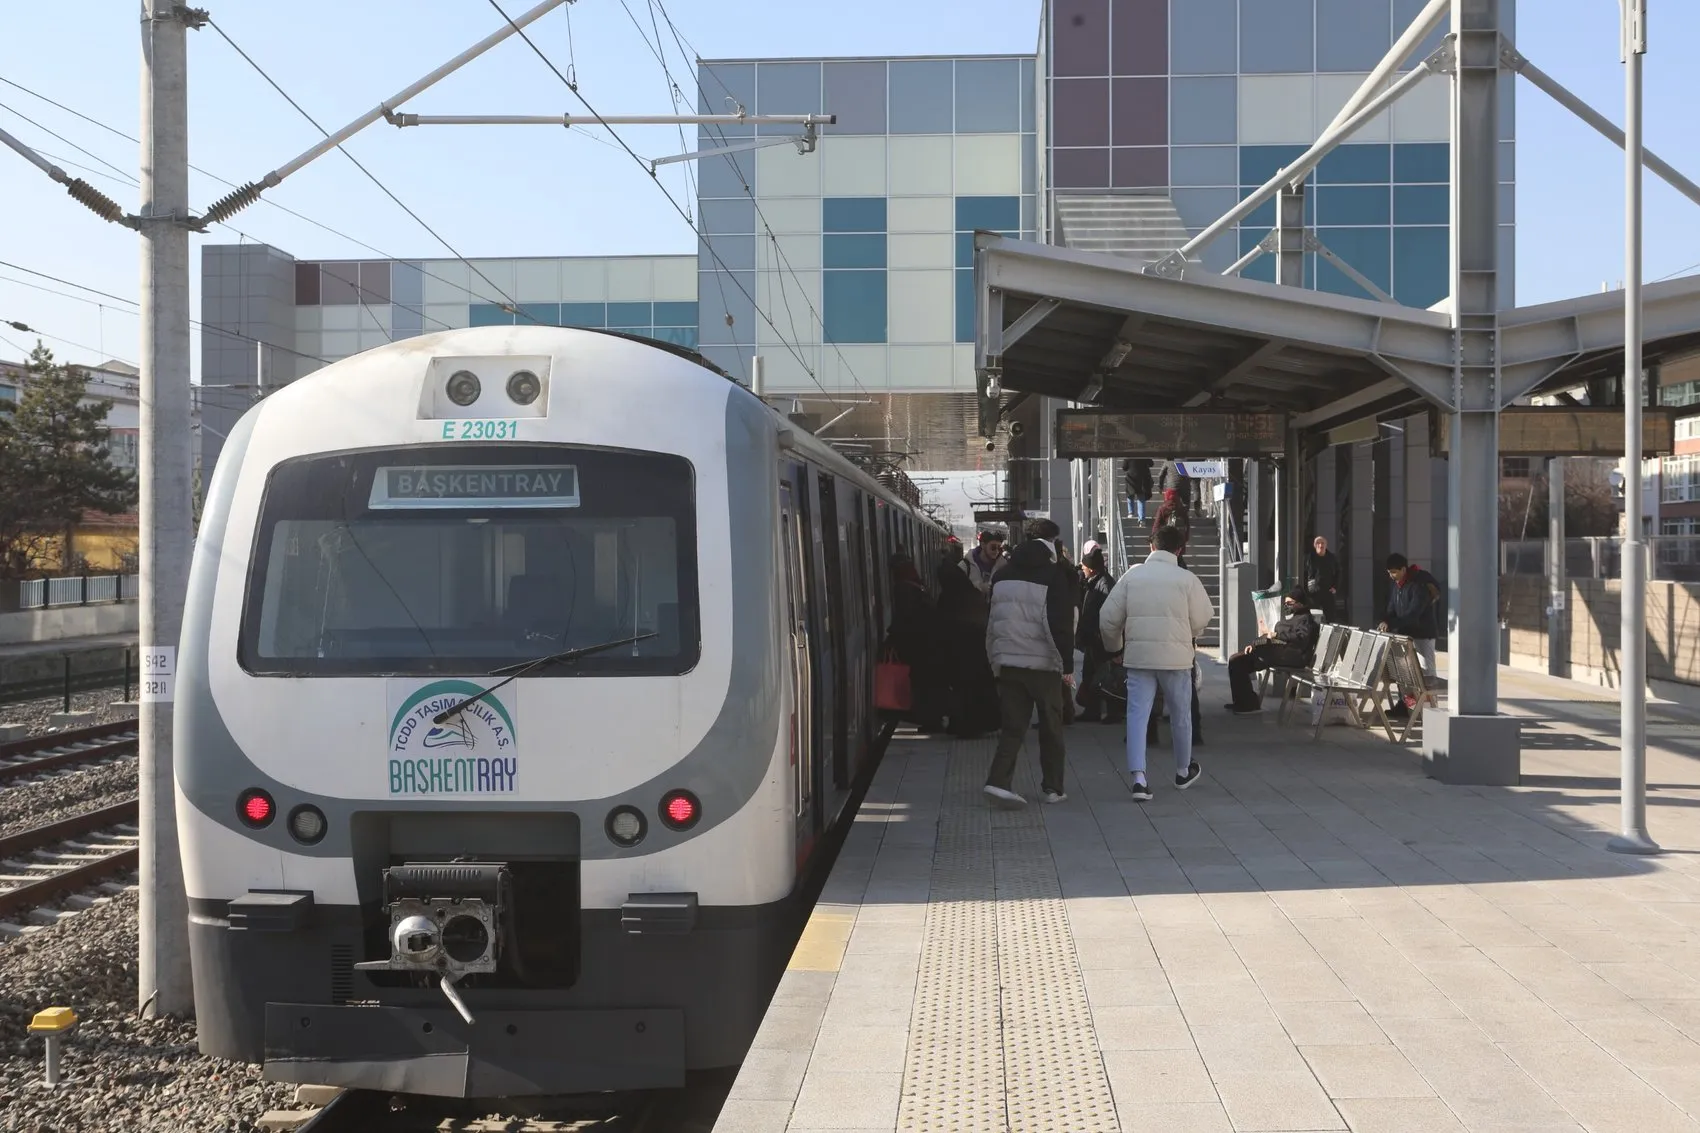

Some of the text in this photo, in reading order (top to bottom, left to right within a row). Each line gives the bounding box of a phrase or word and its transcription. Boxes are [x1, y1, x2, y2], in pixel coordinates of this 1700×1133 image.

[442, 420, 518, 439] E 23031
[398, 473, 562, 497] BAŞKENTRAY
[395, 718, 417, 751] TCDD
